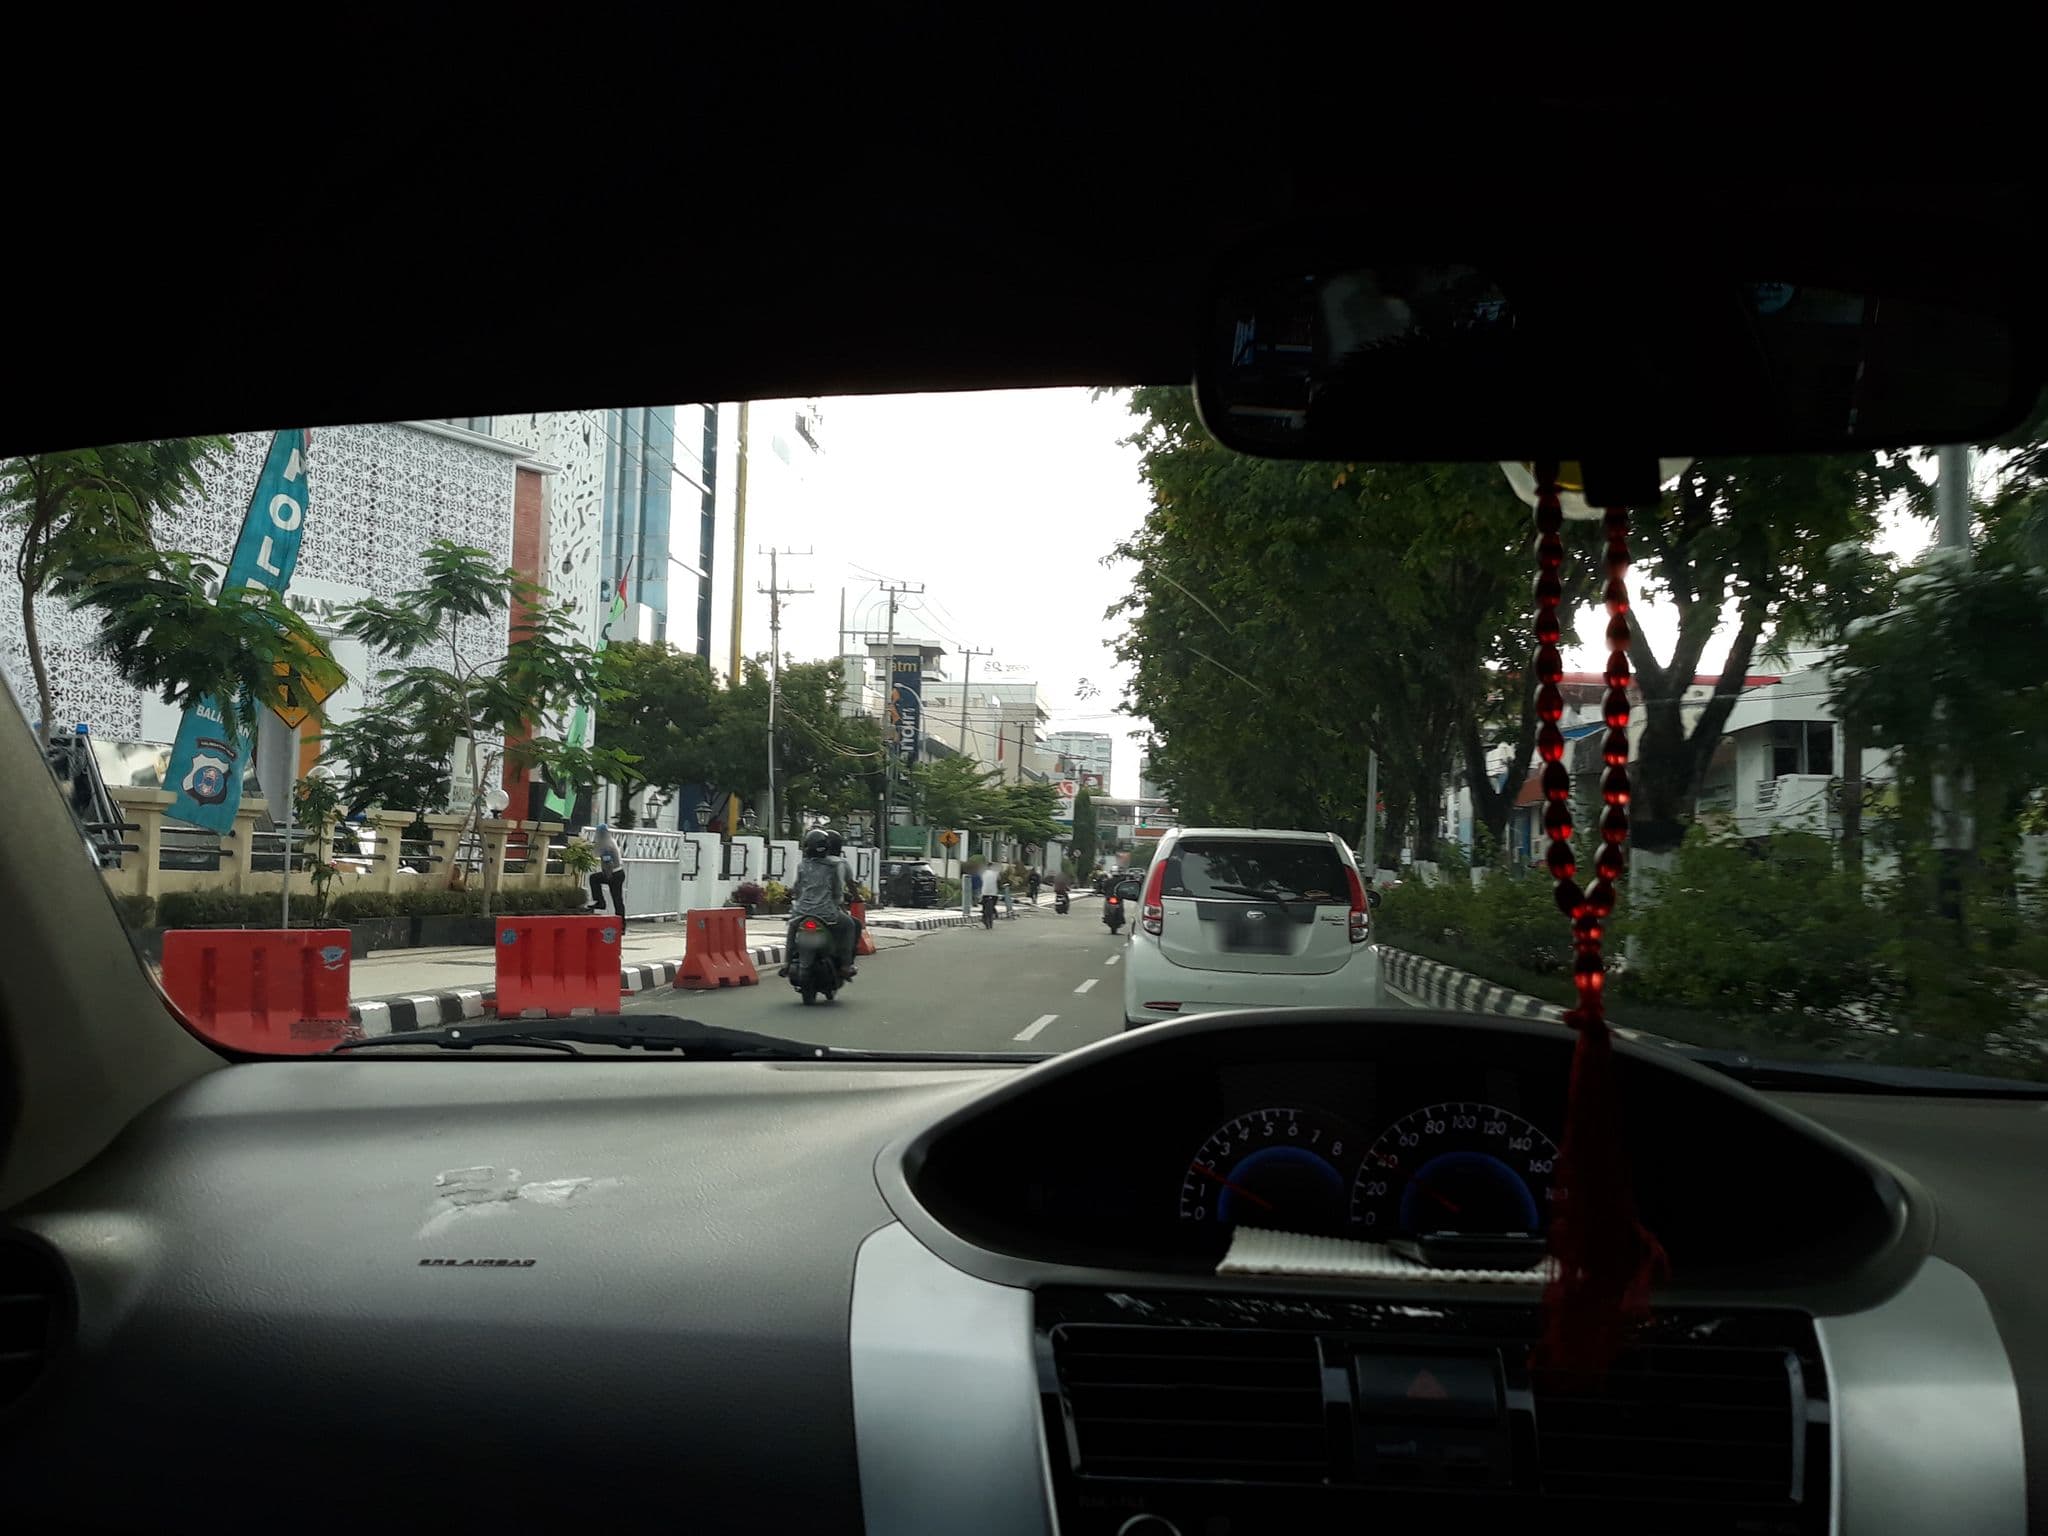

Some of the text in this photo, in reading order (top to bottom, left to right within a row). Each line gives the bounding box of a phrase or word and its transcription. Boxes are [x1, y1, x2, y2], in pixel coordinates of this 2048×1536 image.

[1263, 1121, 1275, 1136] 5
[1287, 1121, 1299, 1137] 6
[1423, 1119, 1446, 1135] 80
[1451, 1114, 1477, 1129] 100
[1482, 1120, 1507, 1136] 120
[1398, 1132, 1420, 1148] 60
[1507, 1136, 1533, 1152] 140
[1219, 1141, 1232, 1156] 3
[1331, 1140, 1343, 1157] 8
[1528, 1158, 1553, 1174] 160
[1366, 1181, 1387, 1197] 20
[456, 1258, 537, 1268] AIRBAG
